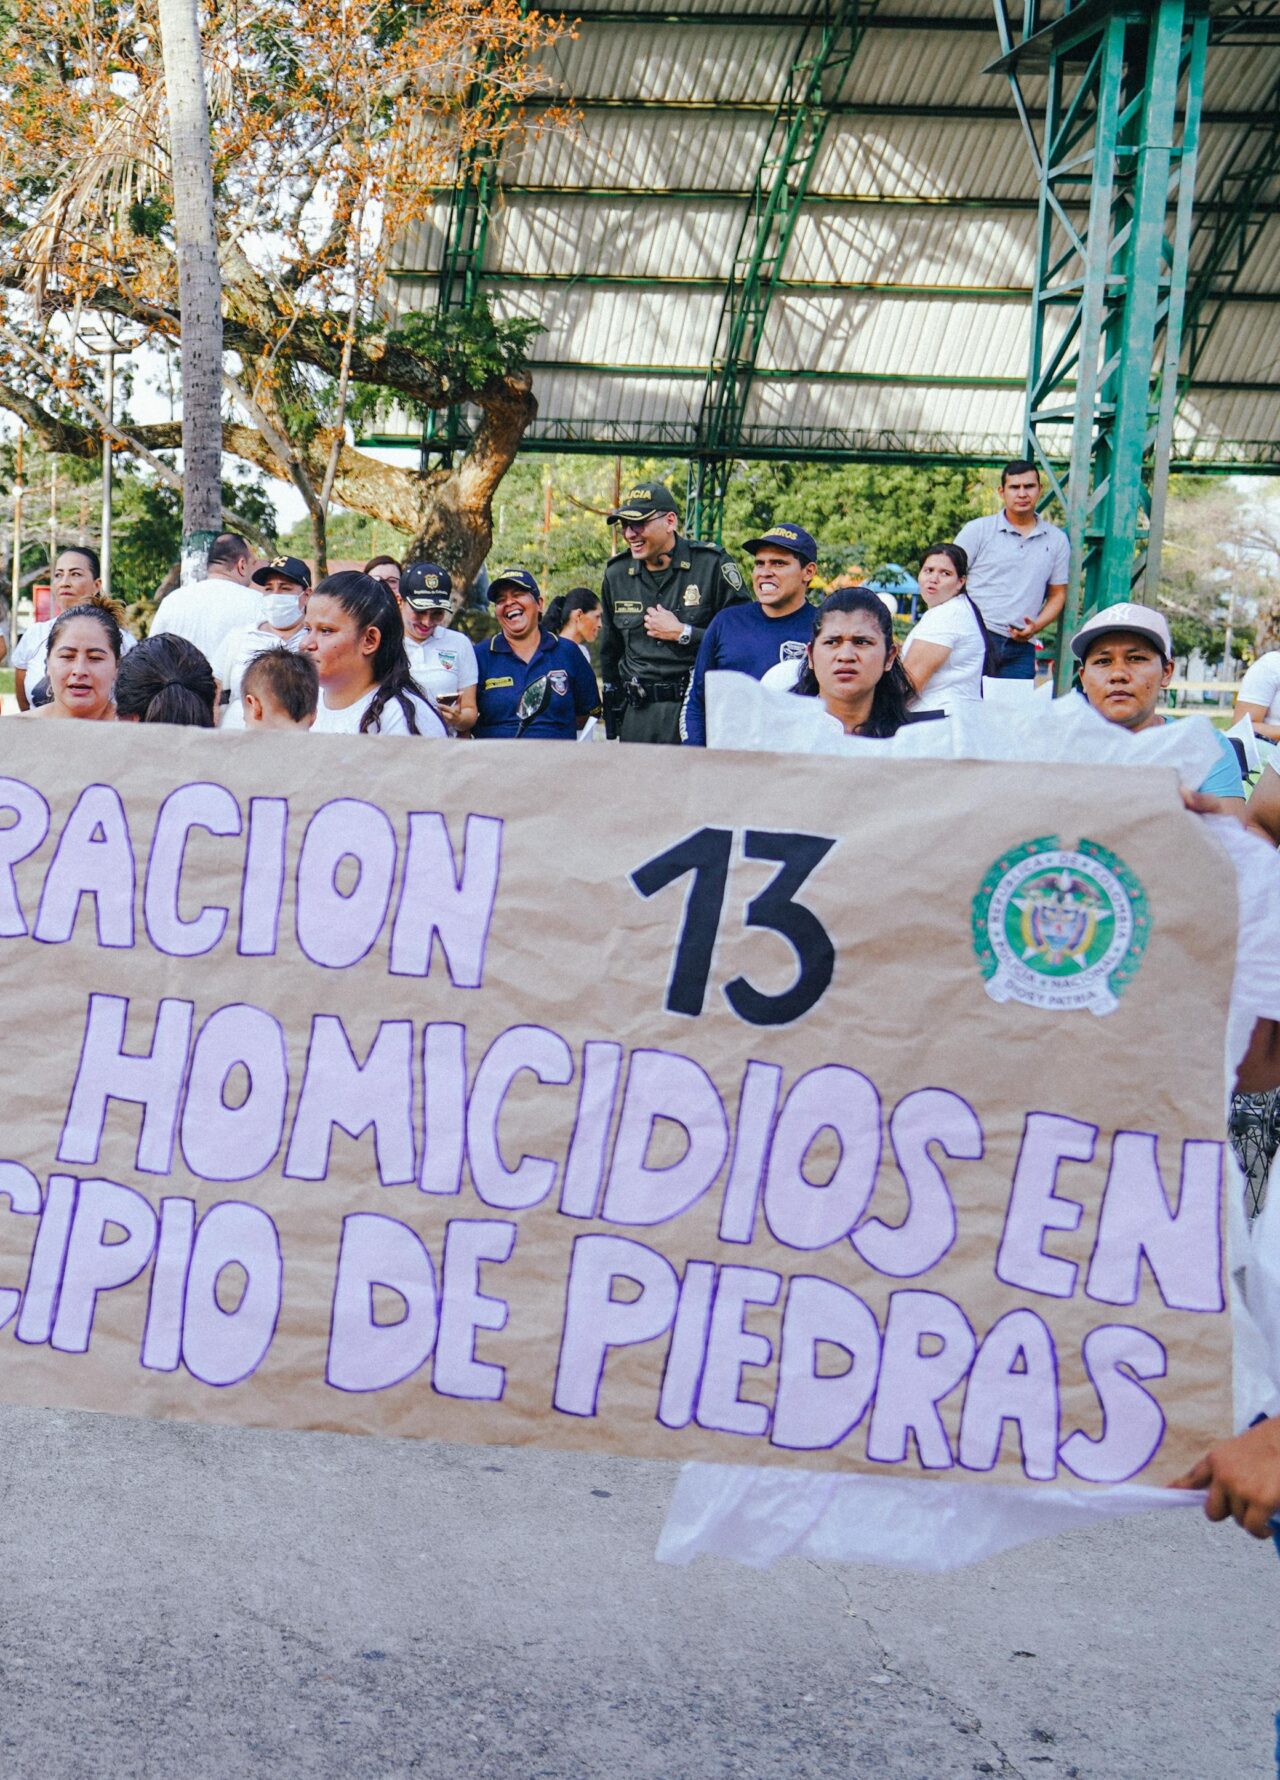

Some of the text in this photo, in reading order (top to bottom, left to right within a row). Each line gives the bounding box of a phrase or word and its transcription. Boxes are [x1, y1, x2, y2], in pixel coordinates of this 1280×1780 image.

[626, 827, 837, 1027] 13
[55, 991, 984, 1278] HOMICIDIOS
[994, 1110, 1227, 1313] EN
[324, 1211, 518, 1401] DE
[552, 1233, 1168, 1484] PIEDRAS
